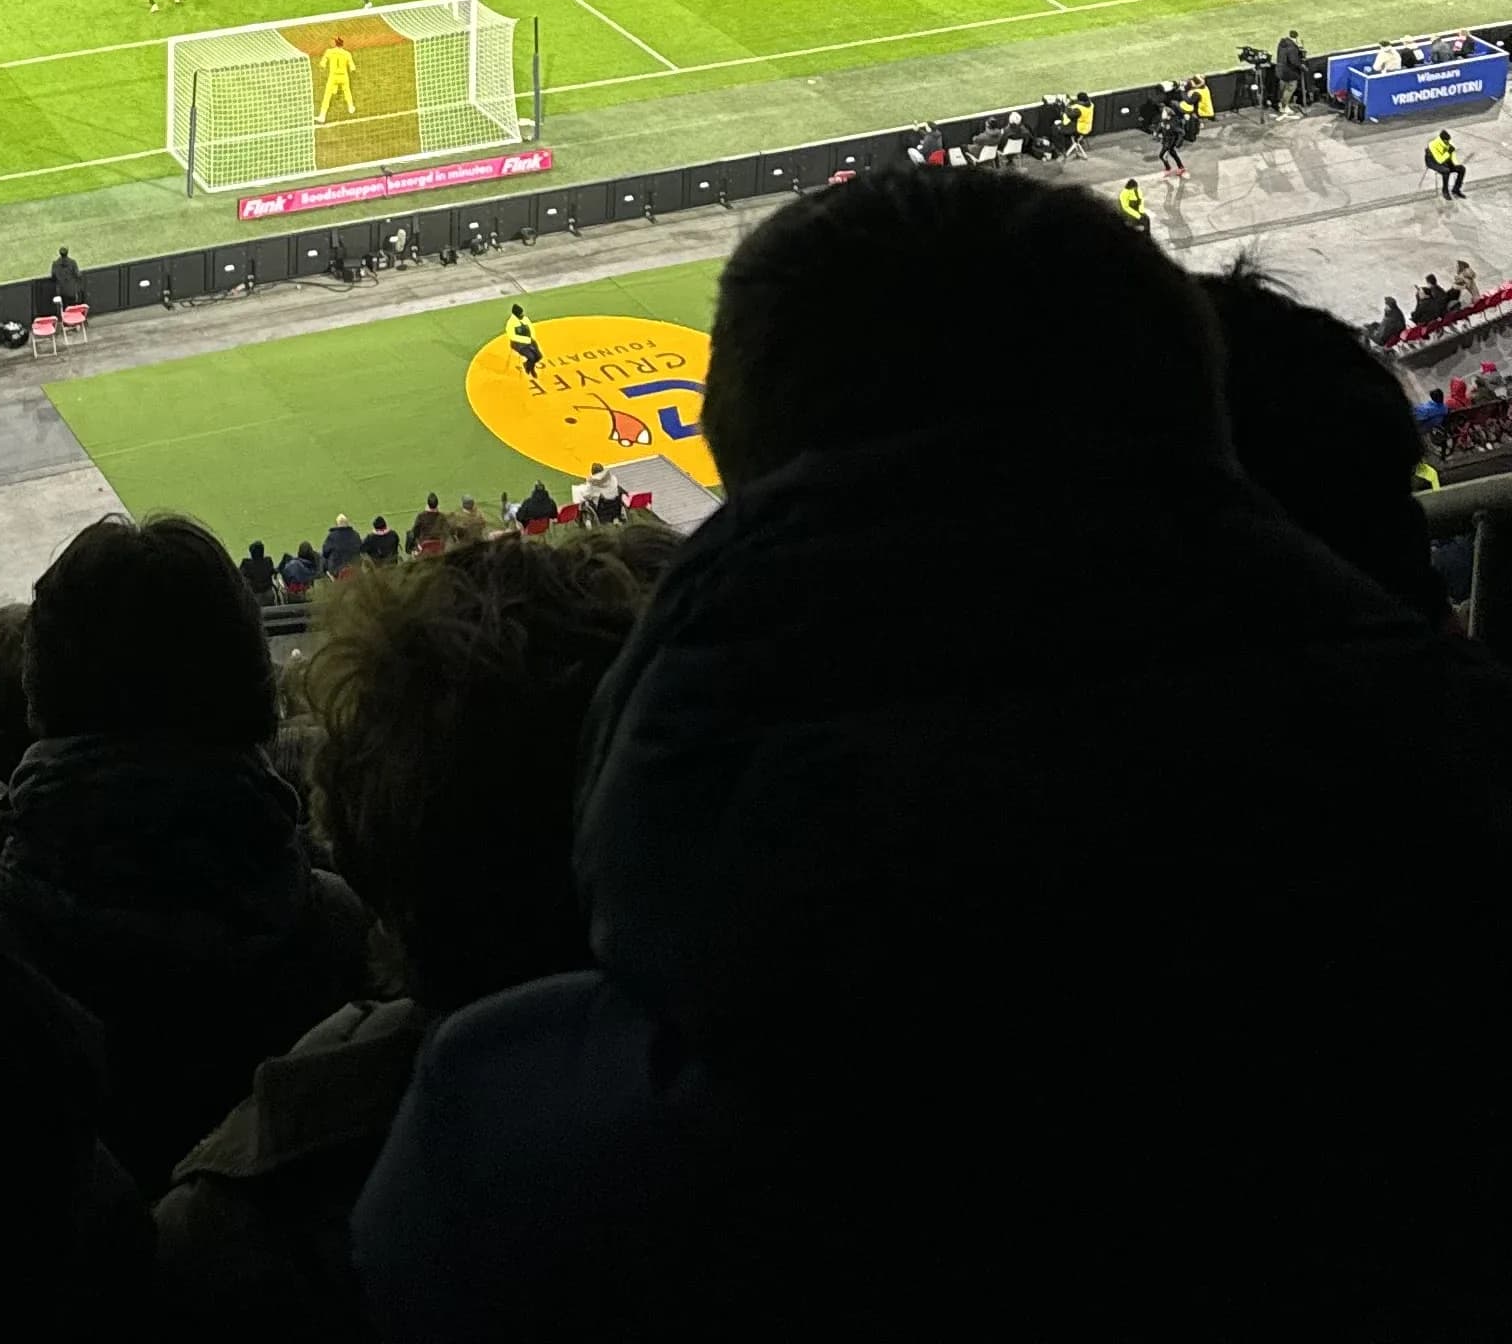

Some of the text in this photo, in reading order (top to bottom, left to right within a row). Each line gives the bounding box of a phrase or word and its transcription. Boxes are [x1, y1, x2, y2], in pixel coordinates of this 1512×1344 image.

[502, 153, 542, 173] Flink
[301, 182, 385, 205] Boodschappen
[435, 167, 447, 182] in
[448, 163, 494, 180] minuten
[243, 196, 287, 217] Flink
[527, 352, 687, 397] CRUYFF
